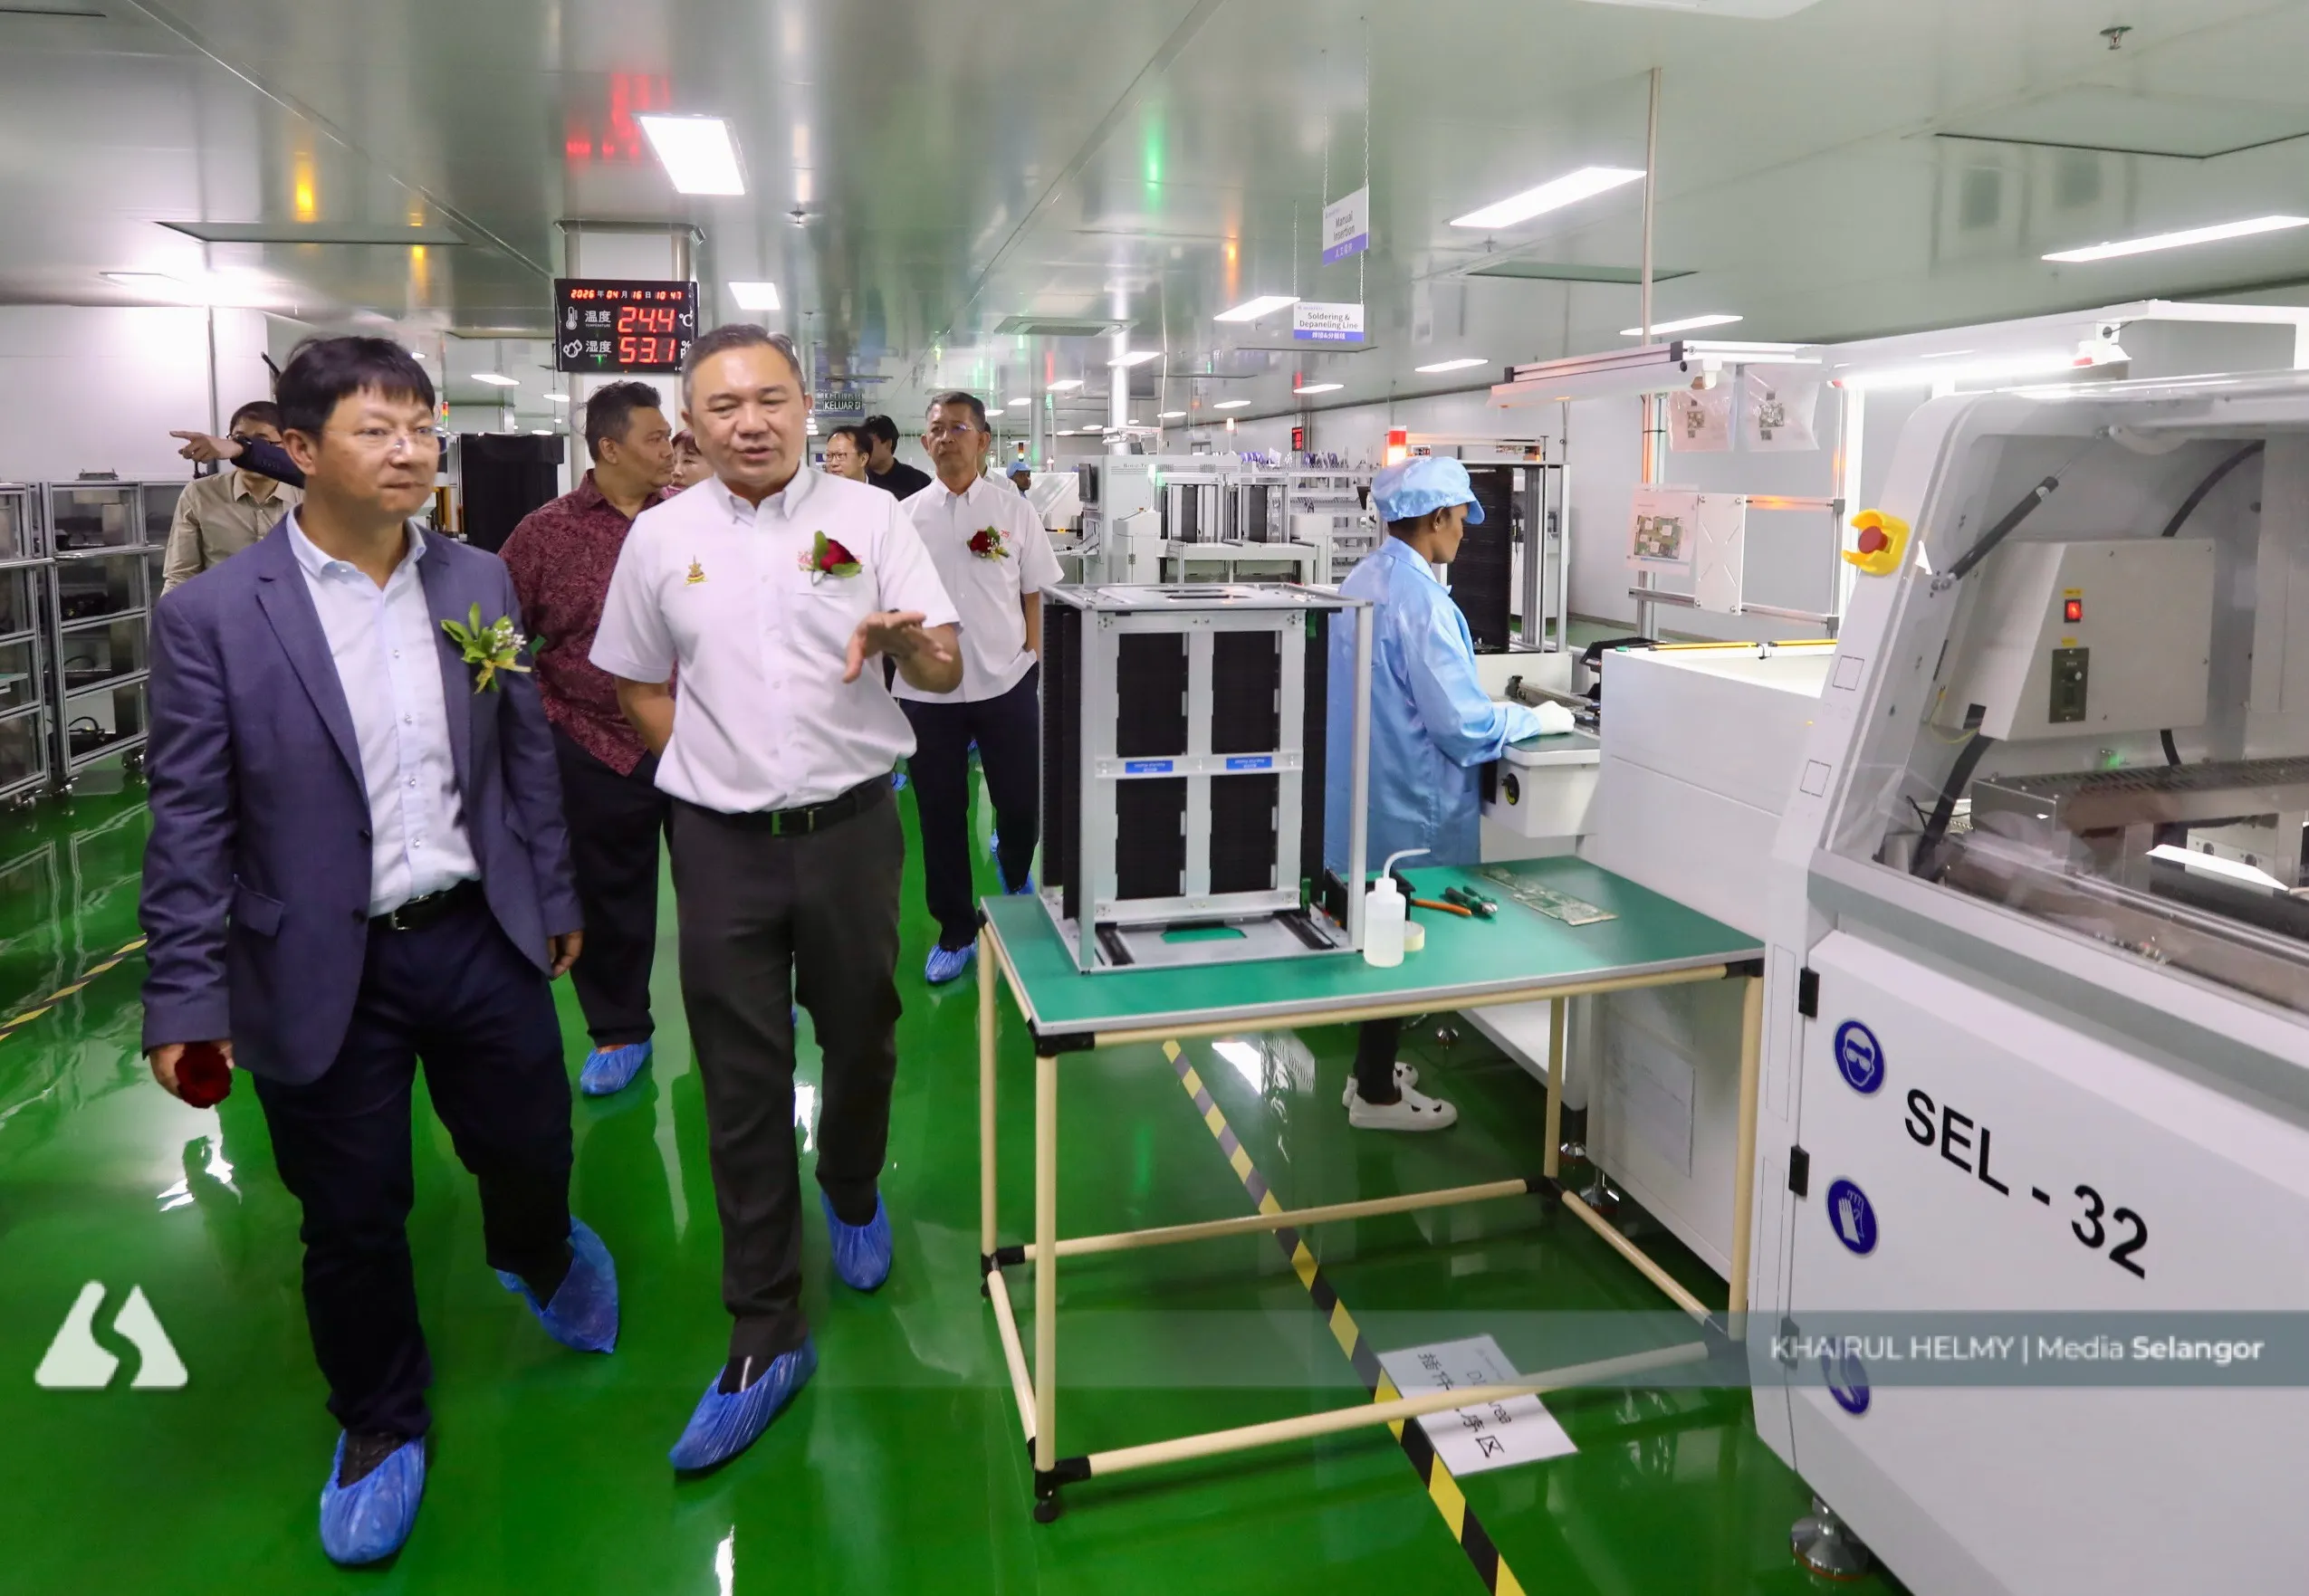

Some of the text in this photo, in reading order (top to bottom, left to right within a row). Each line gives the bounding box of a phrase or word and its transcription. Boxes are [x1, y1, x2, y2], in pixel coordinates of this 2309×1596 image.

[1336, 211, 1354, 228] Manual
[1333, 224, 1356, 242] Insertion
[570, 289, 595, 299] 2026
[598, 290, 604, 299] 年
[606, 290, 618, 299] 04
[621, 290, 628, 299] 月
[632, 291, 642, 300] 16
[645, 291, 651, 299] 日
[585, 310, 611, 323] 温度
[618, 306, 675, 332] 24.4
[1308, 311, 1343, 321] Soldering
[1299, 320, 1358, 330] Depaneling Line
[586, 340, 612, 353] 湿度
[619, 338, 675, 362] 53.1
[825, 401, 854, 409] KELUAR
[1904, 1088, 2148, 1280] SEL - 32
